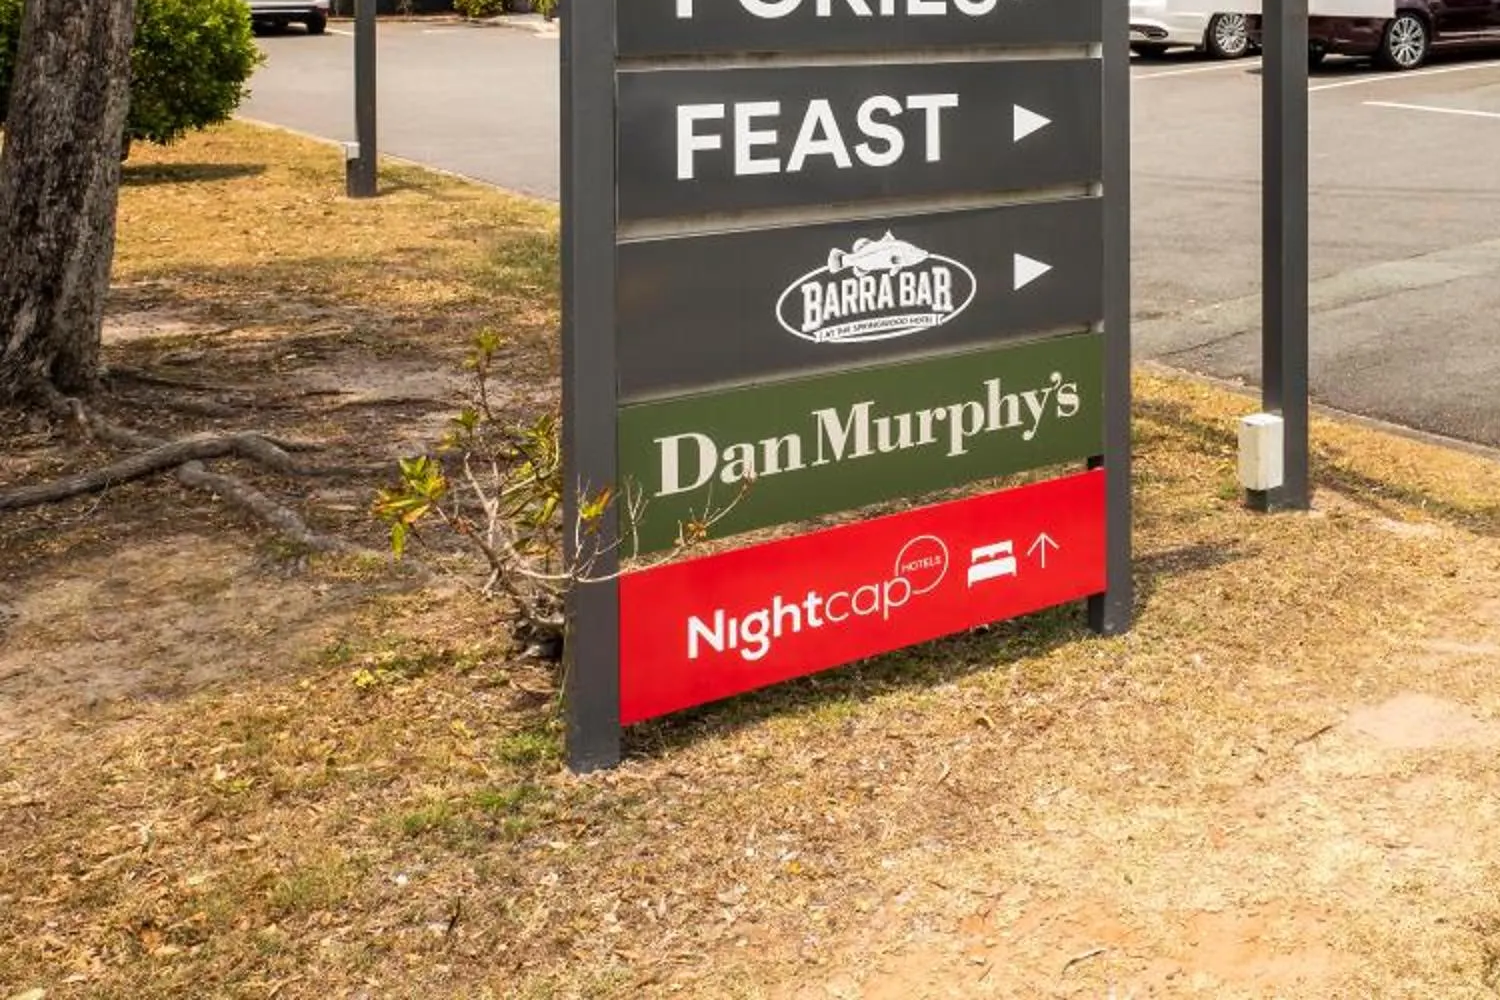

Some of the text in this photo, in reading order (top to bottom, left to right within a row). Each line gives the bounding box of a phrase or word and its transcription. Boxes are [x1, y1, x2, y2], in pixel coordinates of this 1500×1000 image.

[676, 93, 959, 180] FEAST
[801, 265, 954, 333] BARRA BAR
[654, 371, 1081, 497] Dan Murphy's
[900, 554, 942, 574] HOTELS
[687, 575, 912, 662] Nightcap
